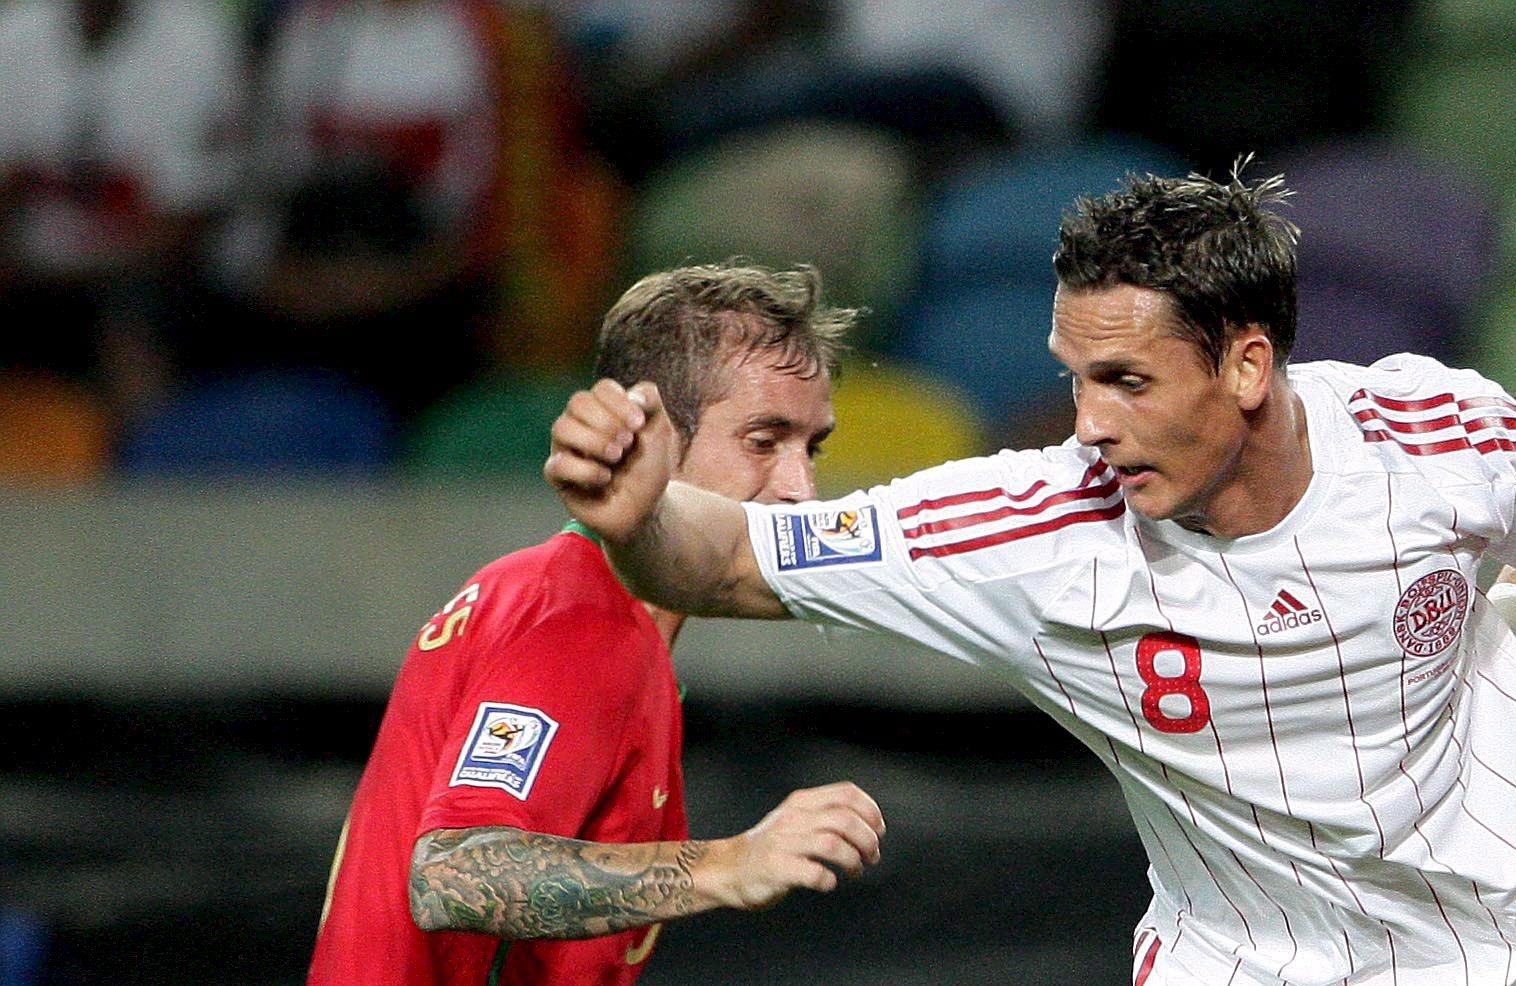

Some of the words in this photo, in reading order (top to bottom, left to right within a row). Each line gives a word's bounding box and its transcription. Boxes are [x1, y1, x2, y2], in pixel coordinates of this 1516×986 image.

[1256, 609, 1322, 637] adidas
[1410, 588, 1457, 633] DBU
[1136, 630, 1211, 734] 8
